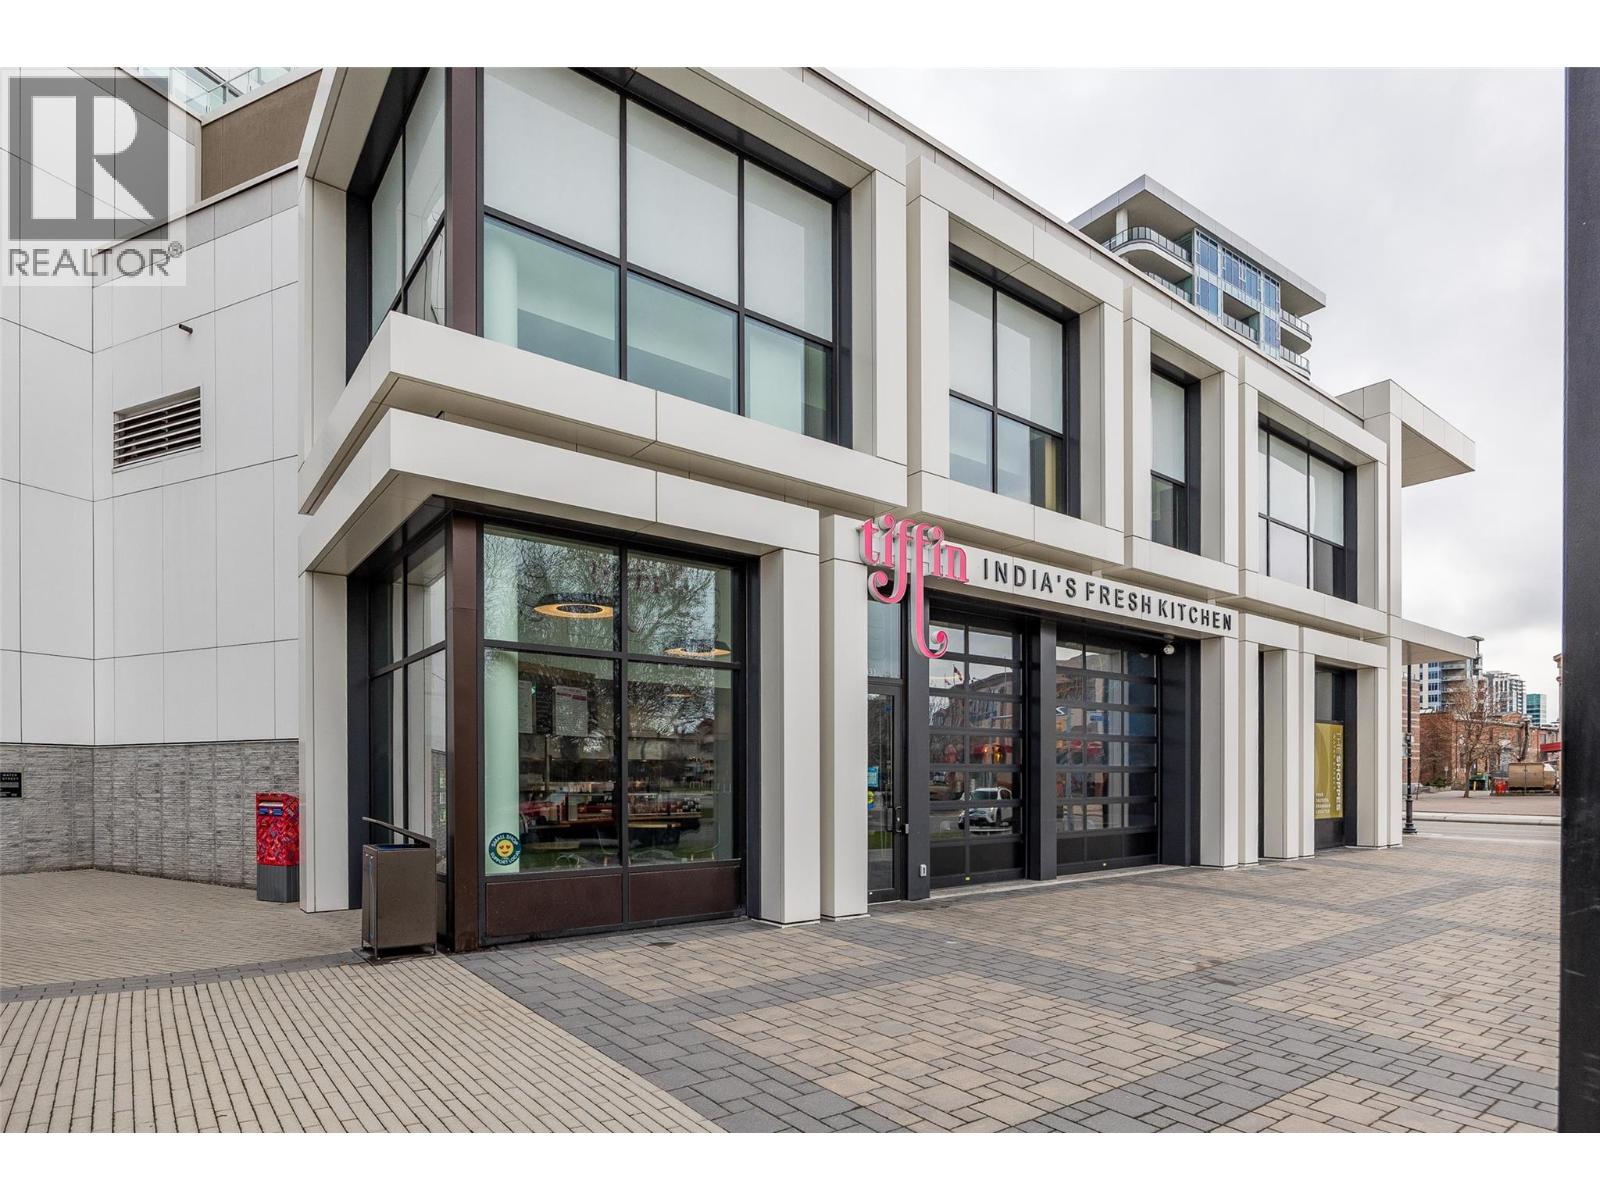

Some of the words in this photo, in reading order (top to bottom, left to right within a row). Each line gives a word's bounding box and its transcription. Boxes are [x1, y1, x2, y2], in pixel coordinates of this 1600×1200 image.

[857, 513, 969, 659] tiffin
[983, 557, 1077, 598] INDIA'S
[1085, 581, 1152, 615] FRESH
[1158, 598, 1232, 632] KITCHEN
